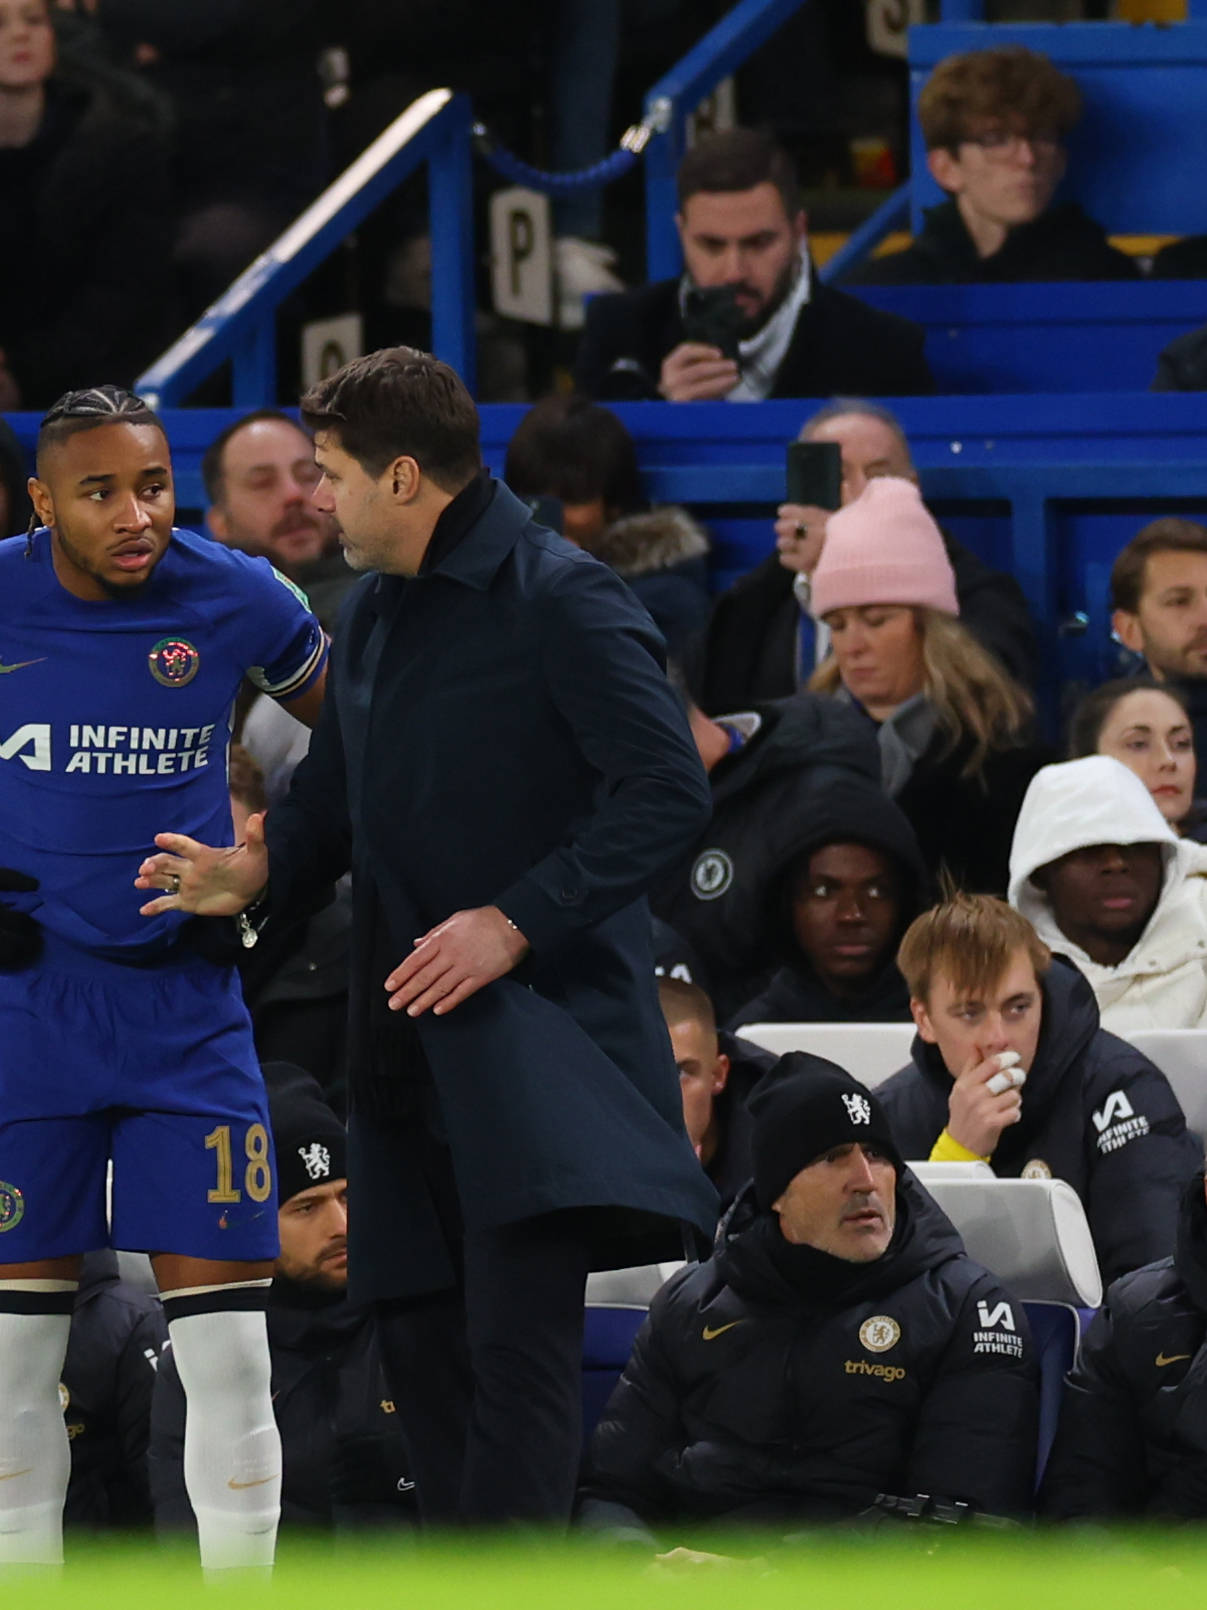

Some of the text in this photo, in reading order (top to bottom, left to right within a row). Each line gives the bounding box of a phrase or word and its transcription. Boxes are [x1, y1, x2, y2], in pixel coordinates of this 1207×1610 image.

[510, 211, 533, 294] P
[69, 724, 215, 750] INFINITE
[65, 747, 209, 774] ATHLETE
[205, 1123, 271, 1203] 18
[973, 1332, 1023, 1347] INFINITE
[973, 1342, 1023, 1359] ATHLETE
[844, 1360, 905, 1382] trivago
